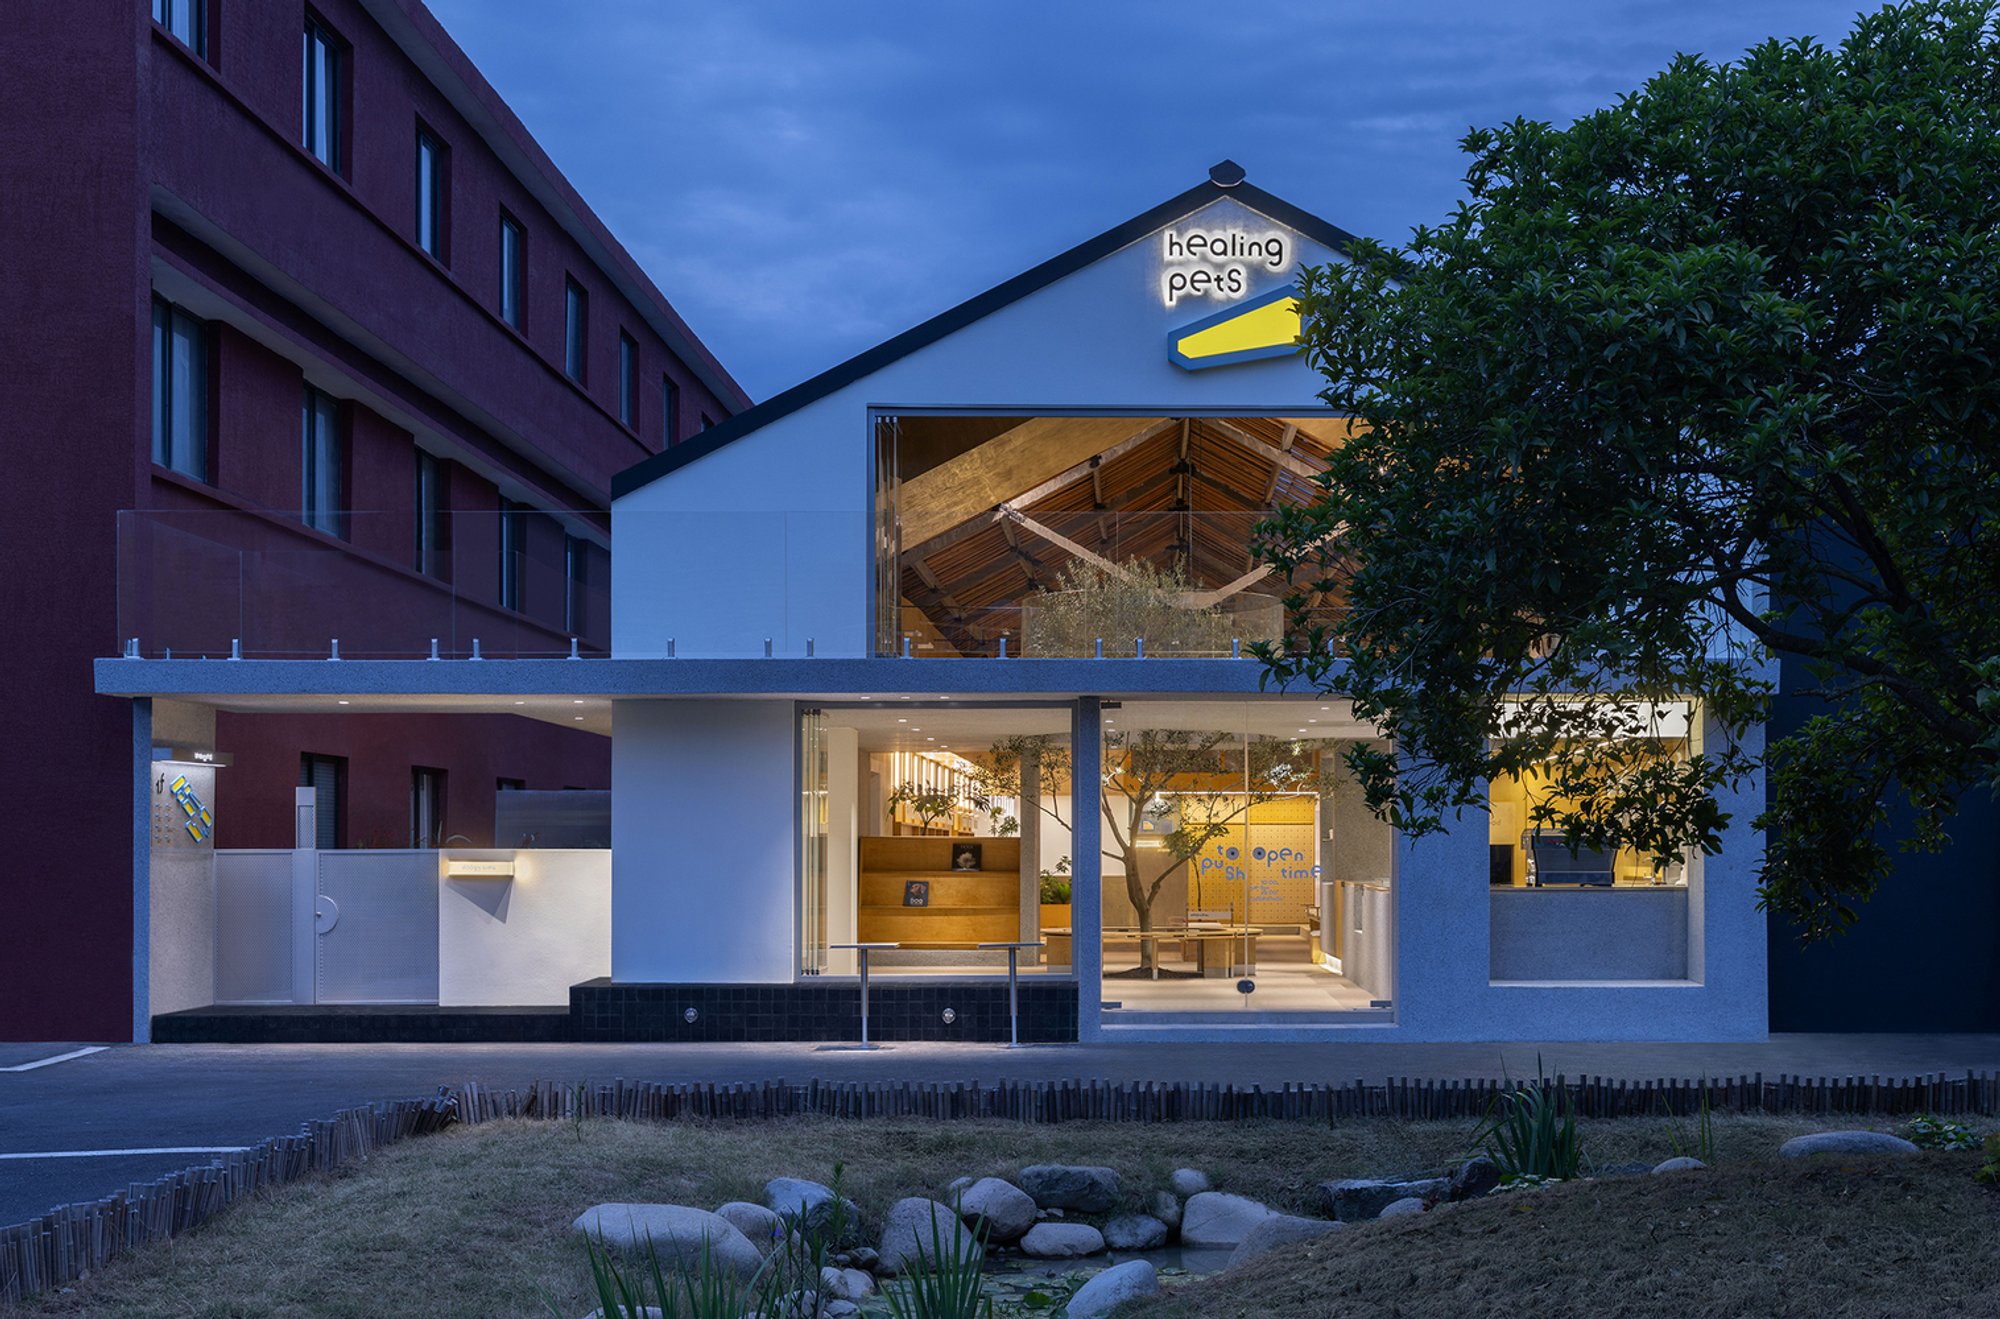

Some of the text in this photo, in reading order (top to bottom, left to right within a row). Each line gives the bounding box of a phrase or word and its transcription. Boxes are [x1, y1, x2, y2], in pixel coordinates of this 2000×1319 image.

[1169, 233, 1283, 266] healing
[1252, 847, 1304, 868] open
[1281, 865, 1324, 879] time
